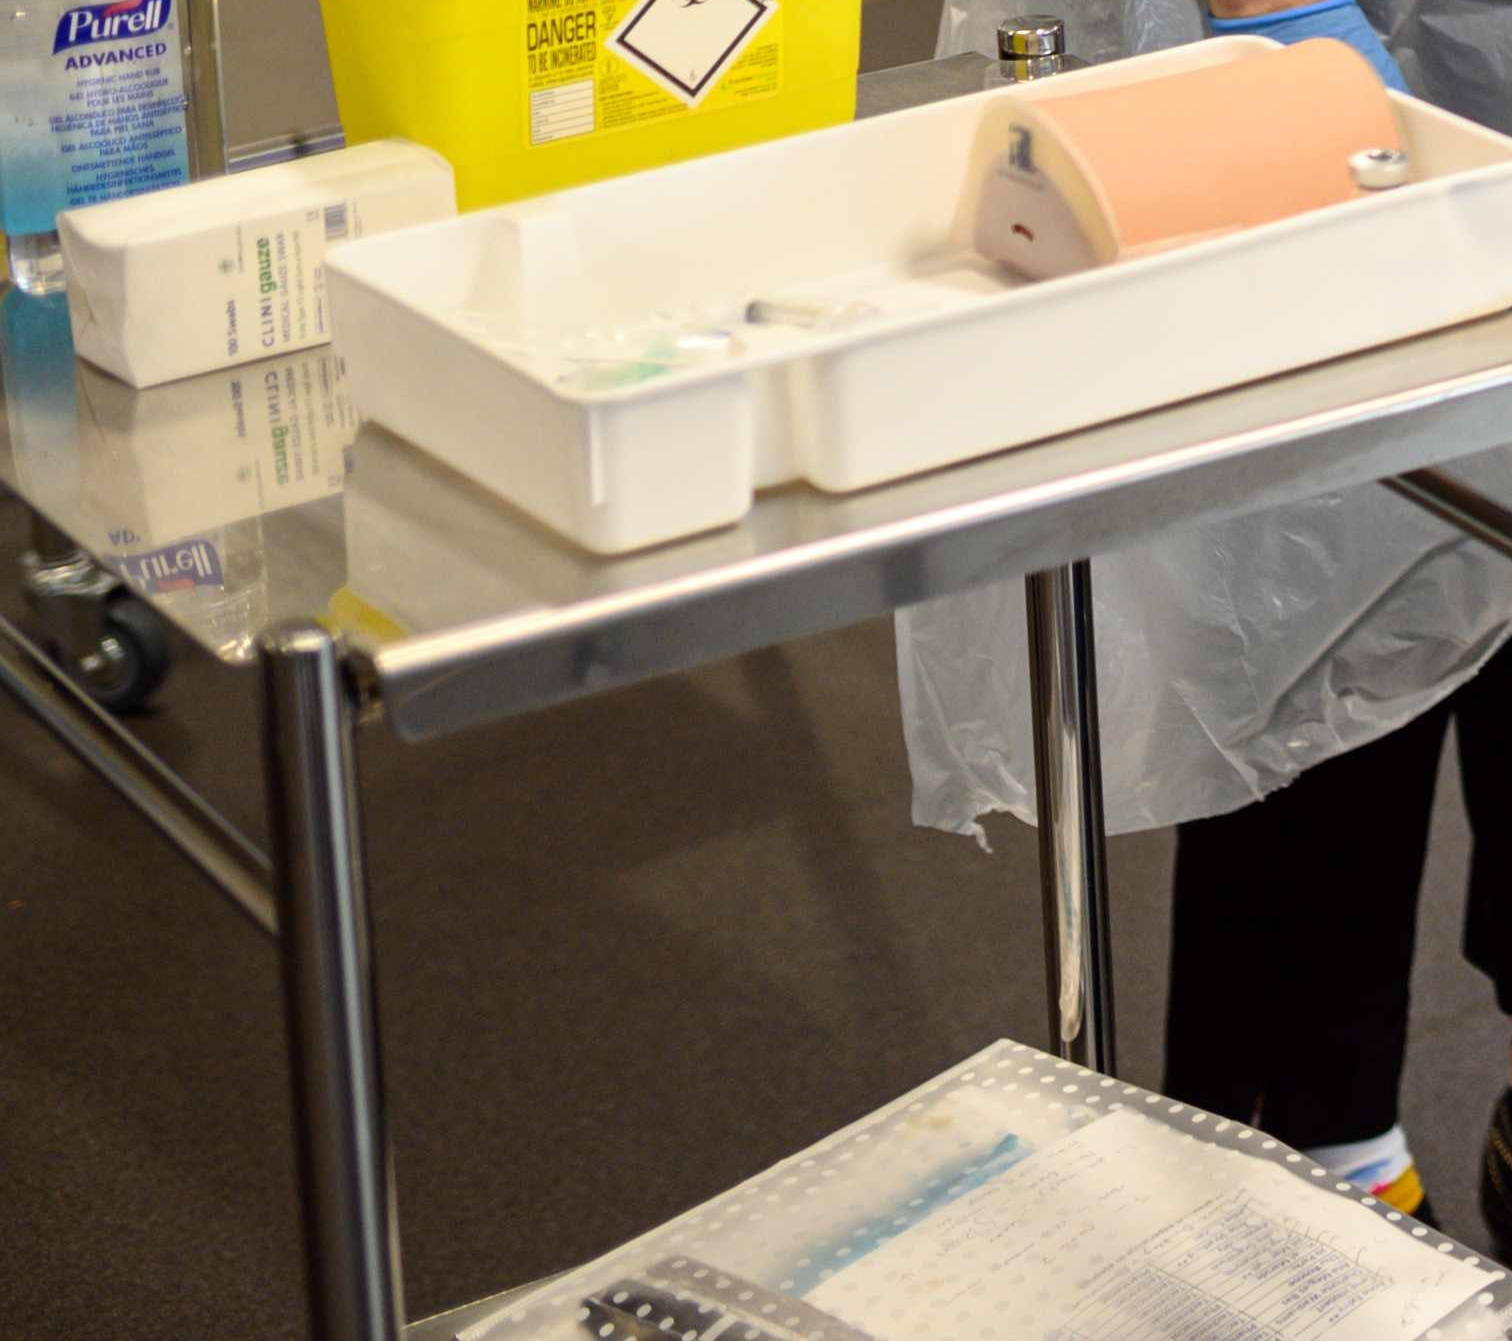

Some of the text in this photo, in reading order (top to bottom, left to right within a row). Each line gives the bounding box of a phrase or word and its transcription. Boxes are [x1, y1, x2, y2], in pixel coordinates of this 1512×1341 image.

[526, 10, 597, 52] DANGER
[65, 43, 167, 70] ADVANCED
[539, 50, 549, 71] BE
[551, 40, 597, 69] INCINERATED
